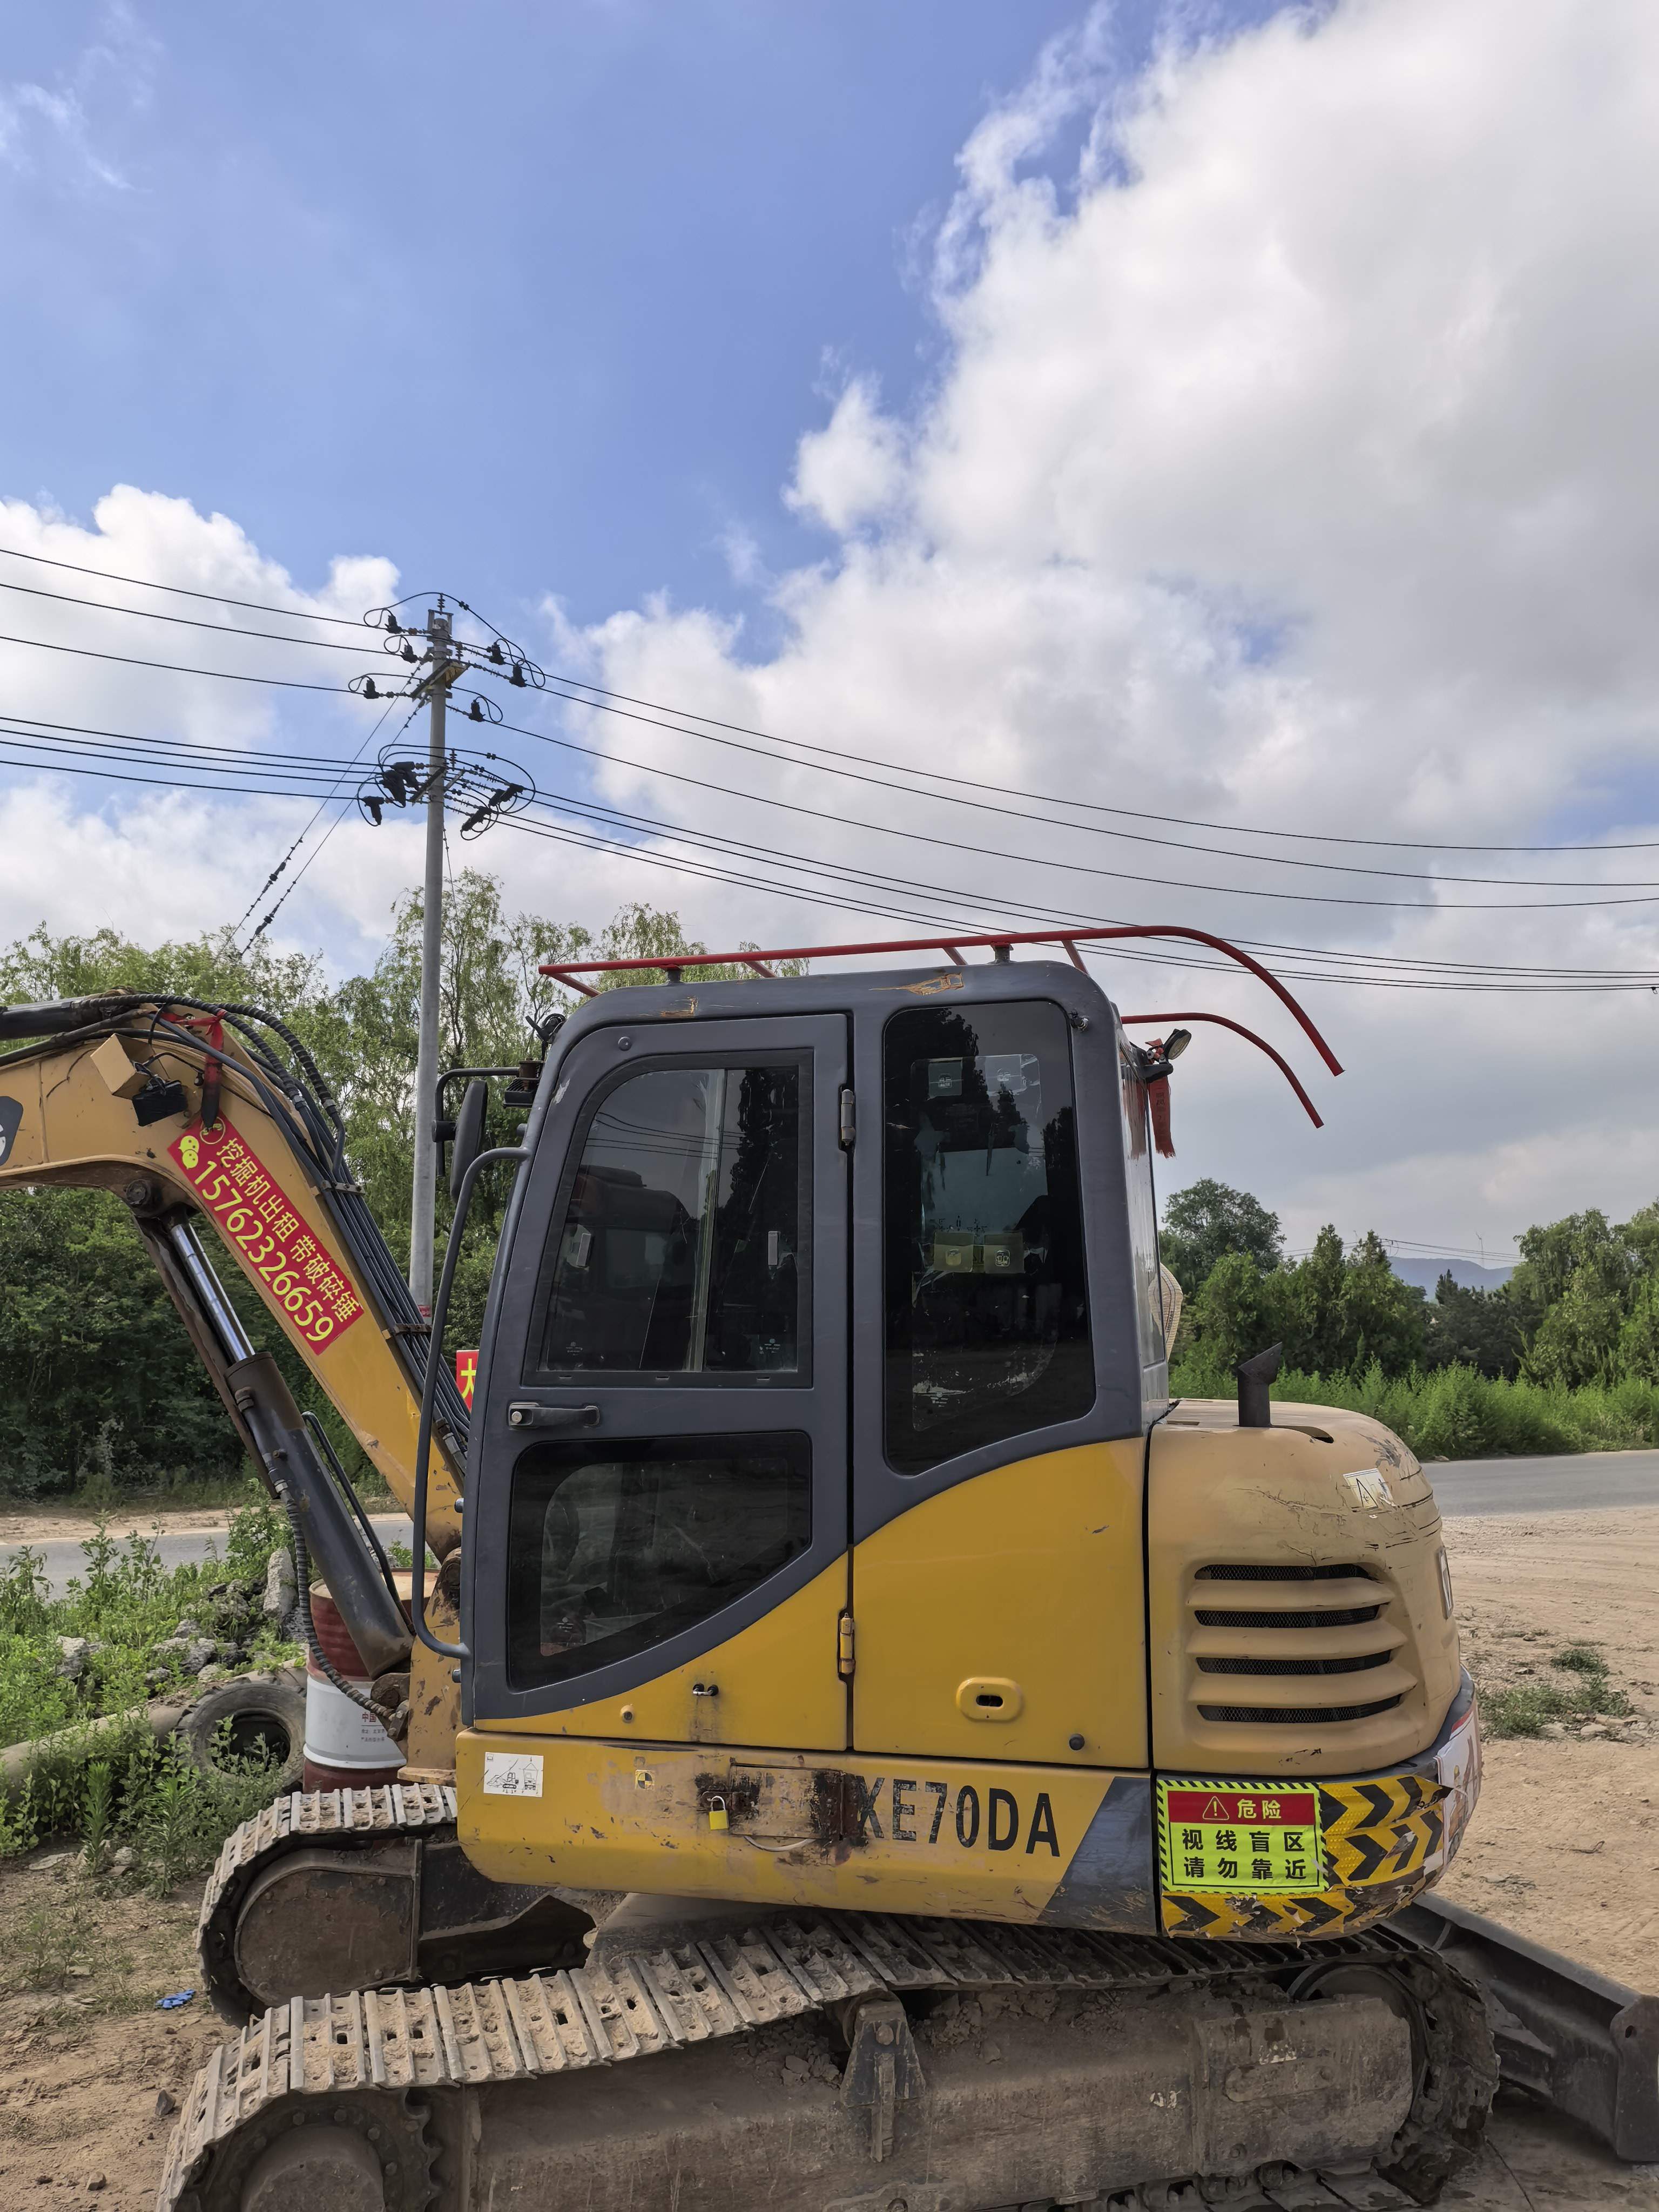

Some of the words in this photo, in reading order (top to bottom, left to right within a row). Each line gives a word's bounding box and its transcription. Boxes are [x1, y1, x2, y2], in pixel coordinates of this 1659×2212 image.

[216, 1137, 299, 1242] 挖掘机出租
[290, 1235, 360, 1323] 带破碎锤
[194, 1161, 334, 1341] 15762326659
[1237, 1798, 1282, 1819] 危险
[1182, 1829, 1305, 1852] 视线盲区
[1183, 1857, 1306, 1880] 请勿靠近
